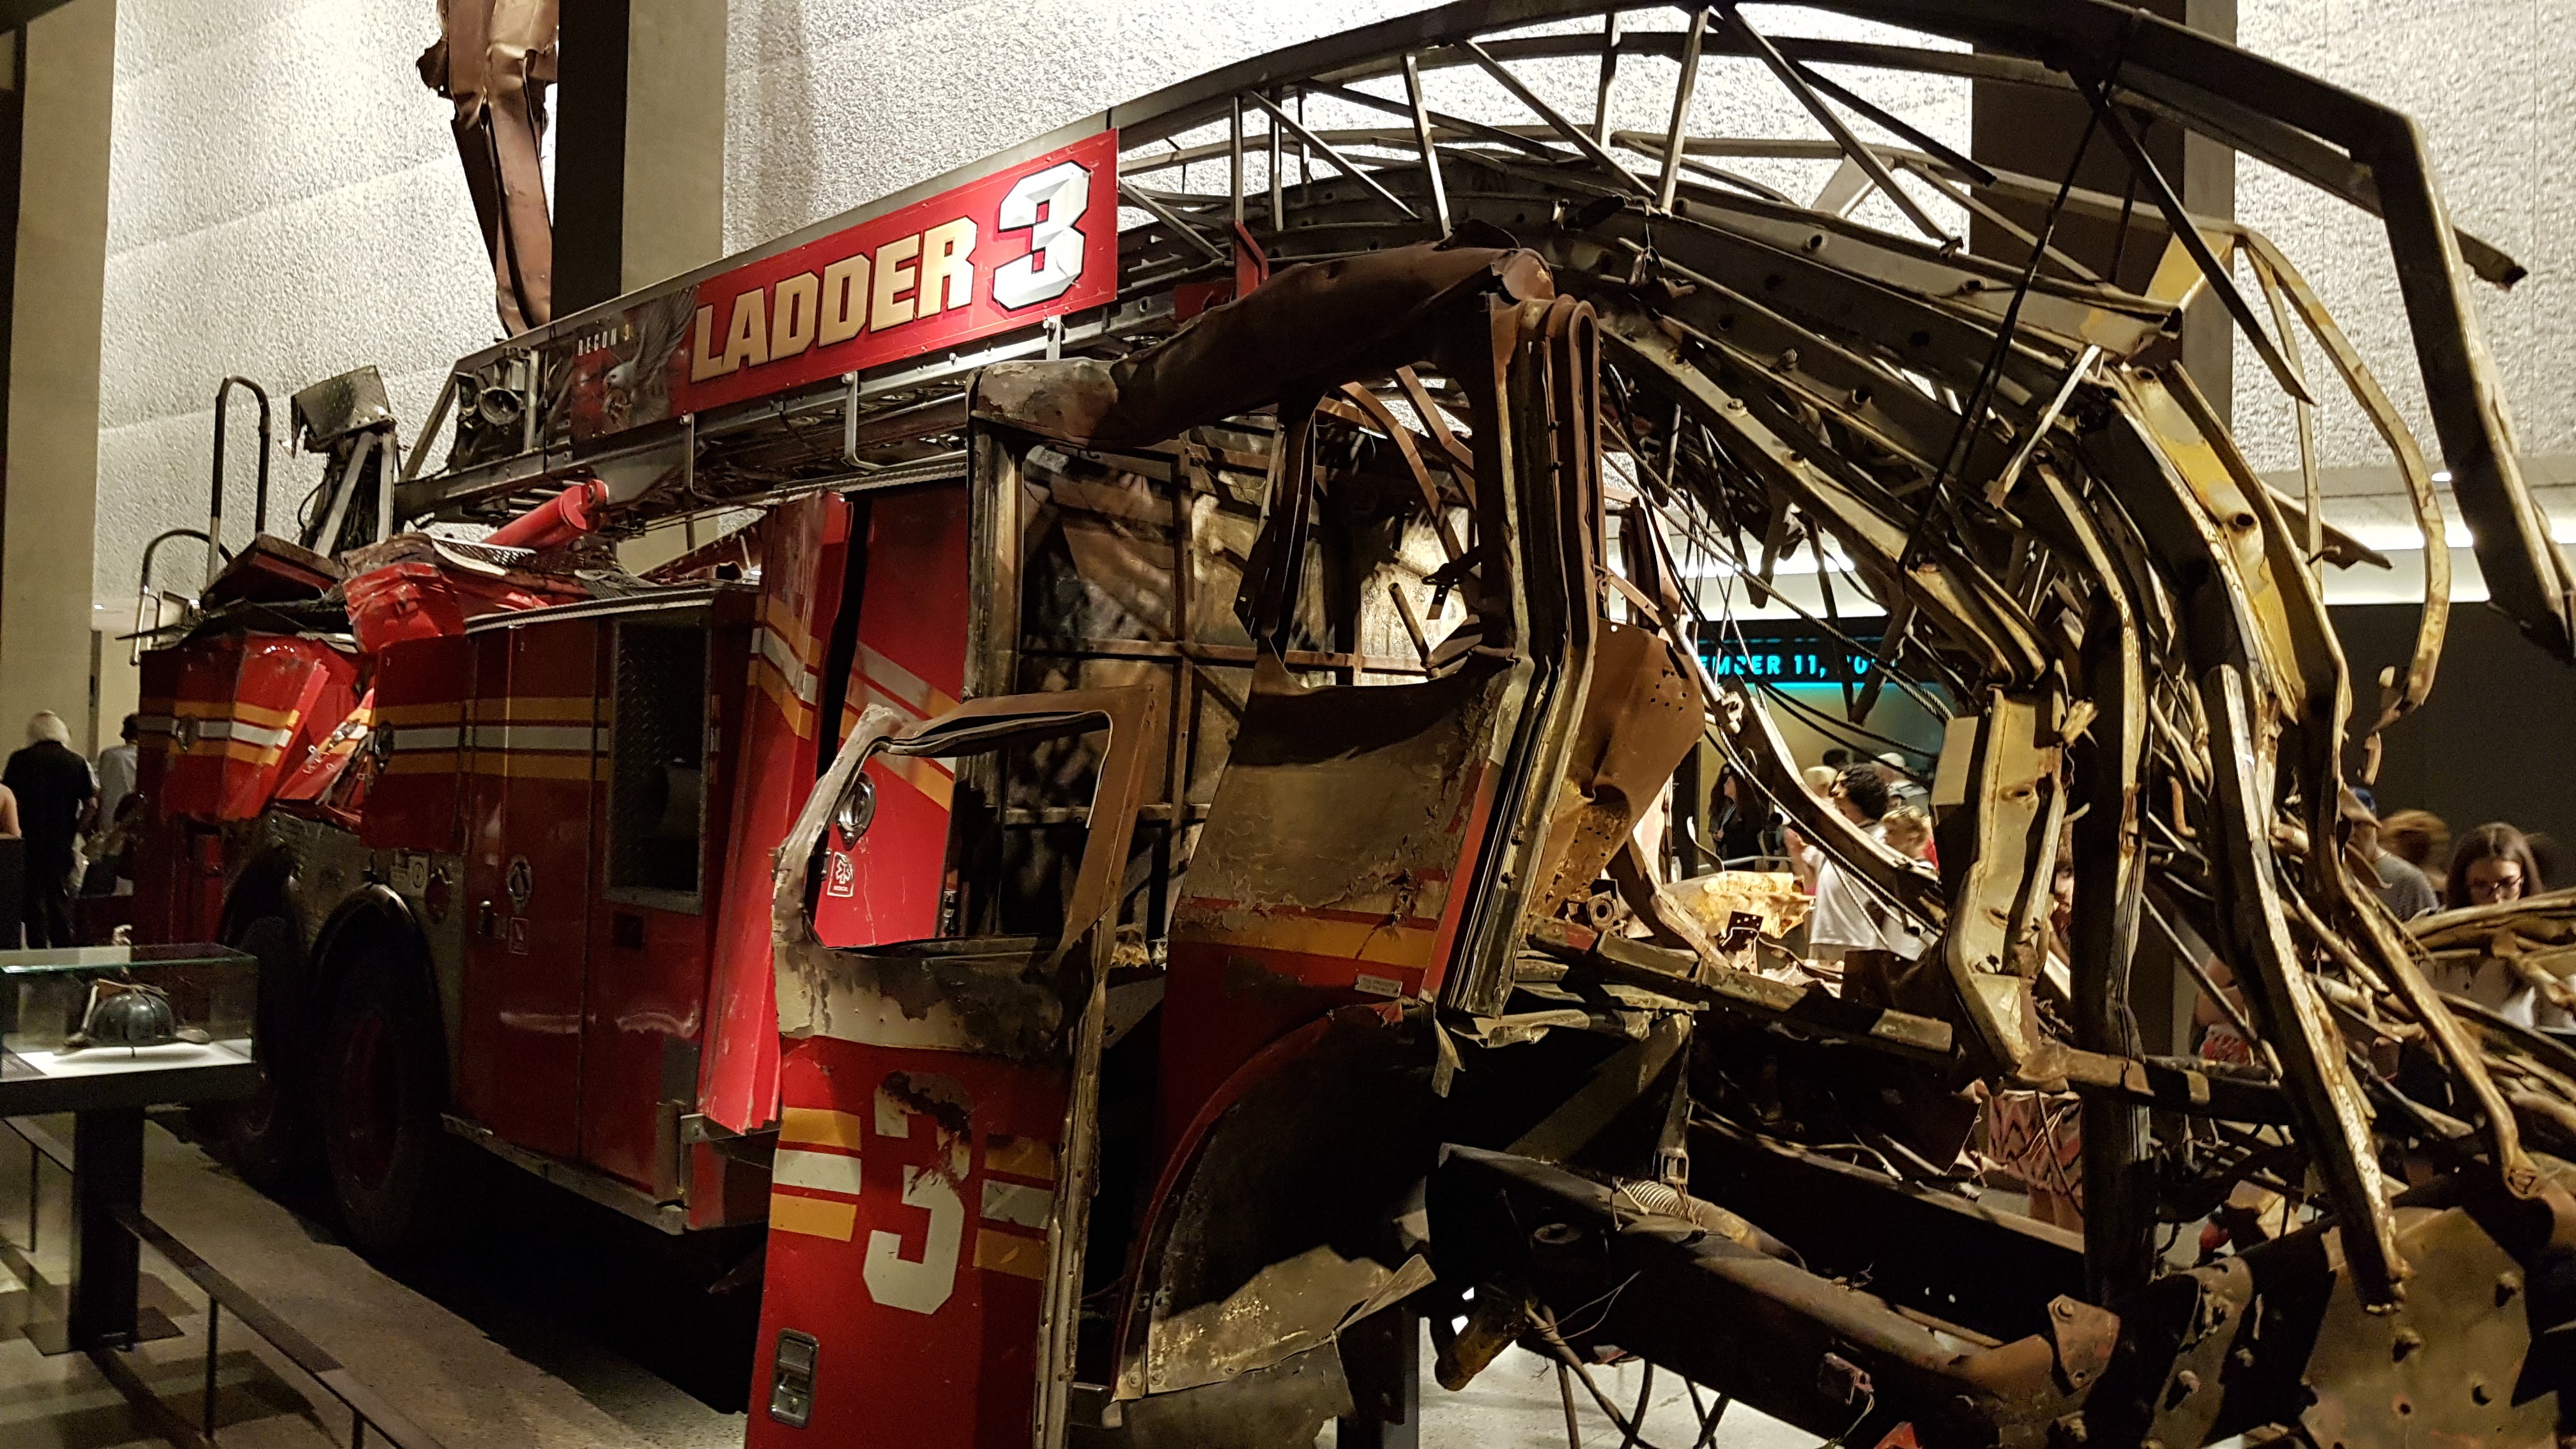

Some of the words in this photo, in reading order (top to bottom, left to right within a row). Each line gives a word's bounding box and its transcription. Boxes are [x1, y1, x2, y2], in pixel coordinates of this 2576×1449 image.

[691, 215, 978, 383] LADDER
[993, 160, 1090, 311] 3
[1793, 654, 1827, 678] 11,
[864, 1071, 972, 1314] 3
